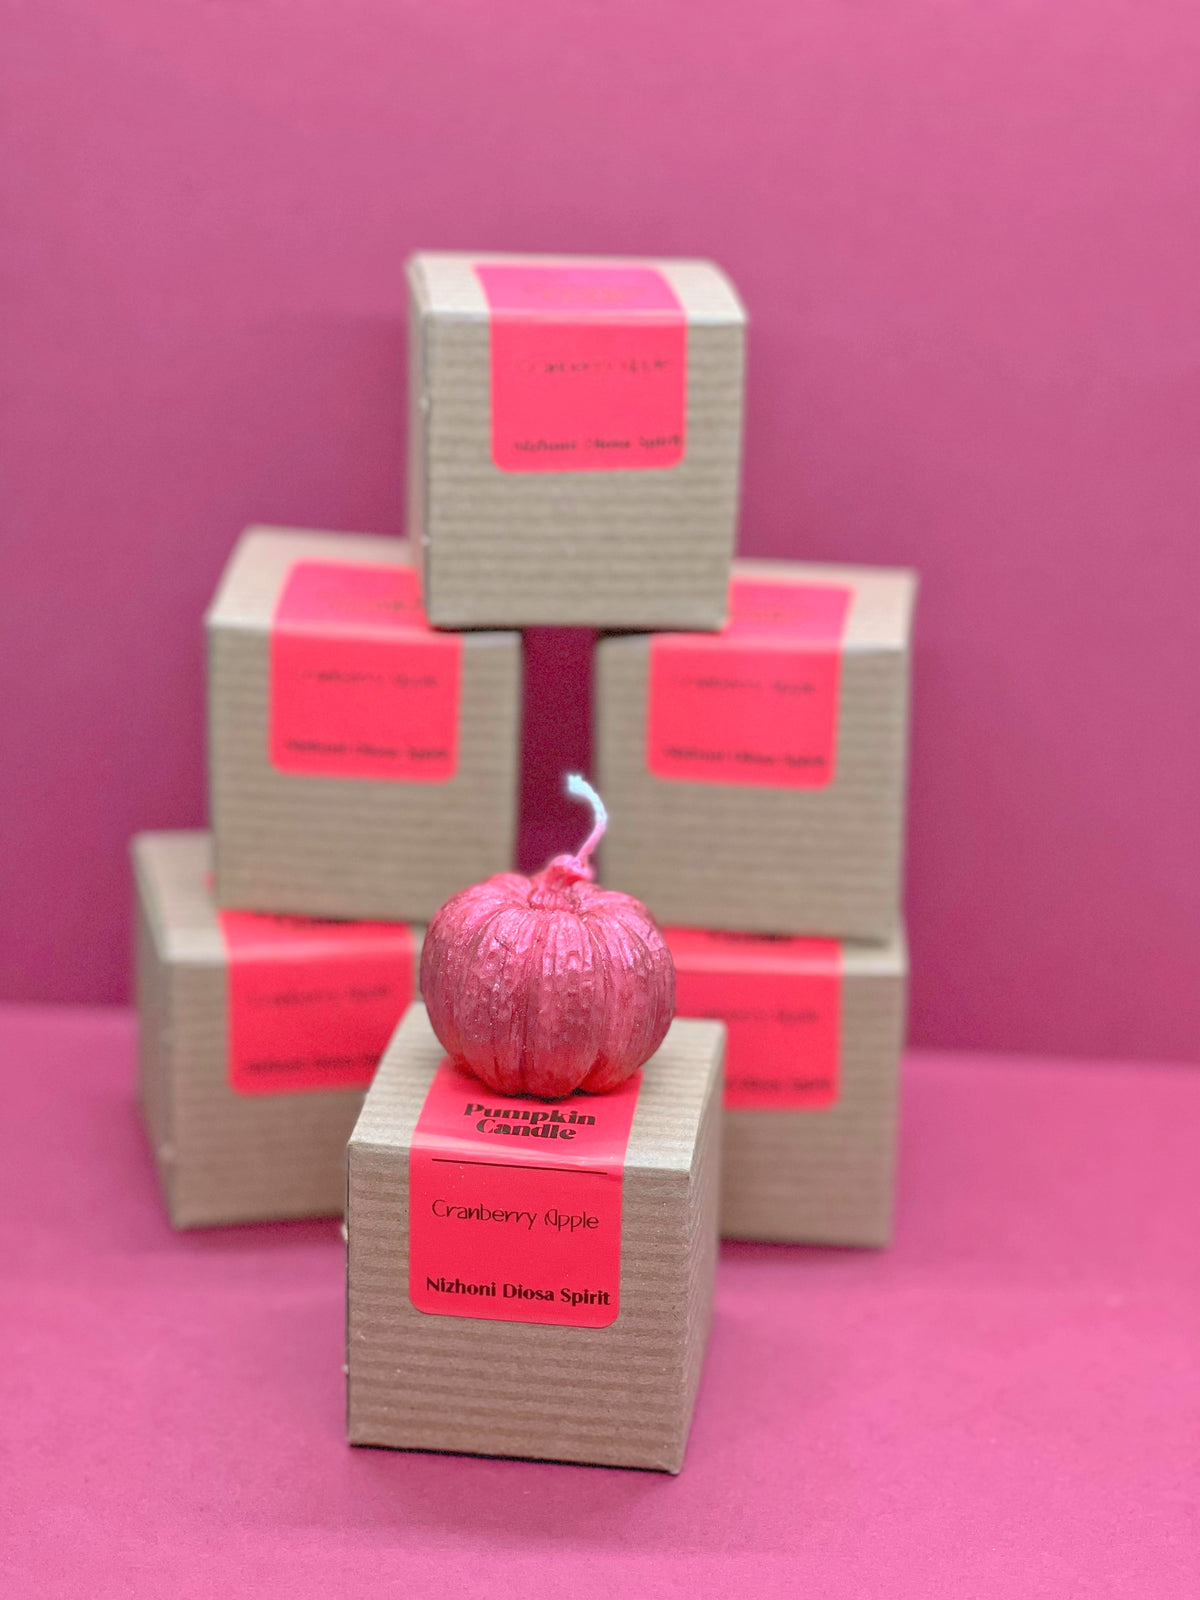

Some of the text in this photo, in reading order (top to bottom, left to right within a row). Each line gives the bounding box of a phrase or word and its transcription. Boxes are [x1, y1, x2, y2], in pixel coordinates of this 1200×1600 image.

[463, 1103, 596, 1125] Pumpkin
[476, 1118, 577, 1140] Candle
[431, 1199, 600, 1232] Cranberry Apple
[426, 1276, 612, 1307] Nizhoni Diosa Spirit
